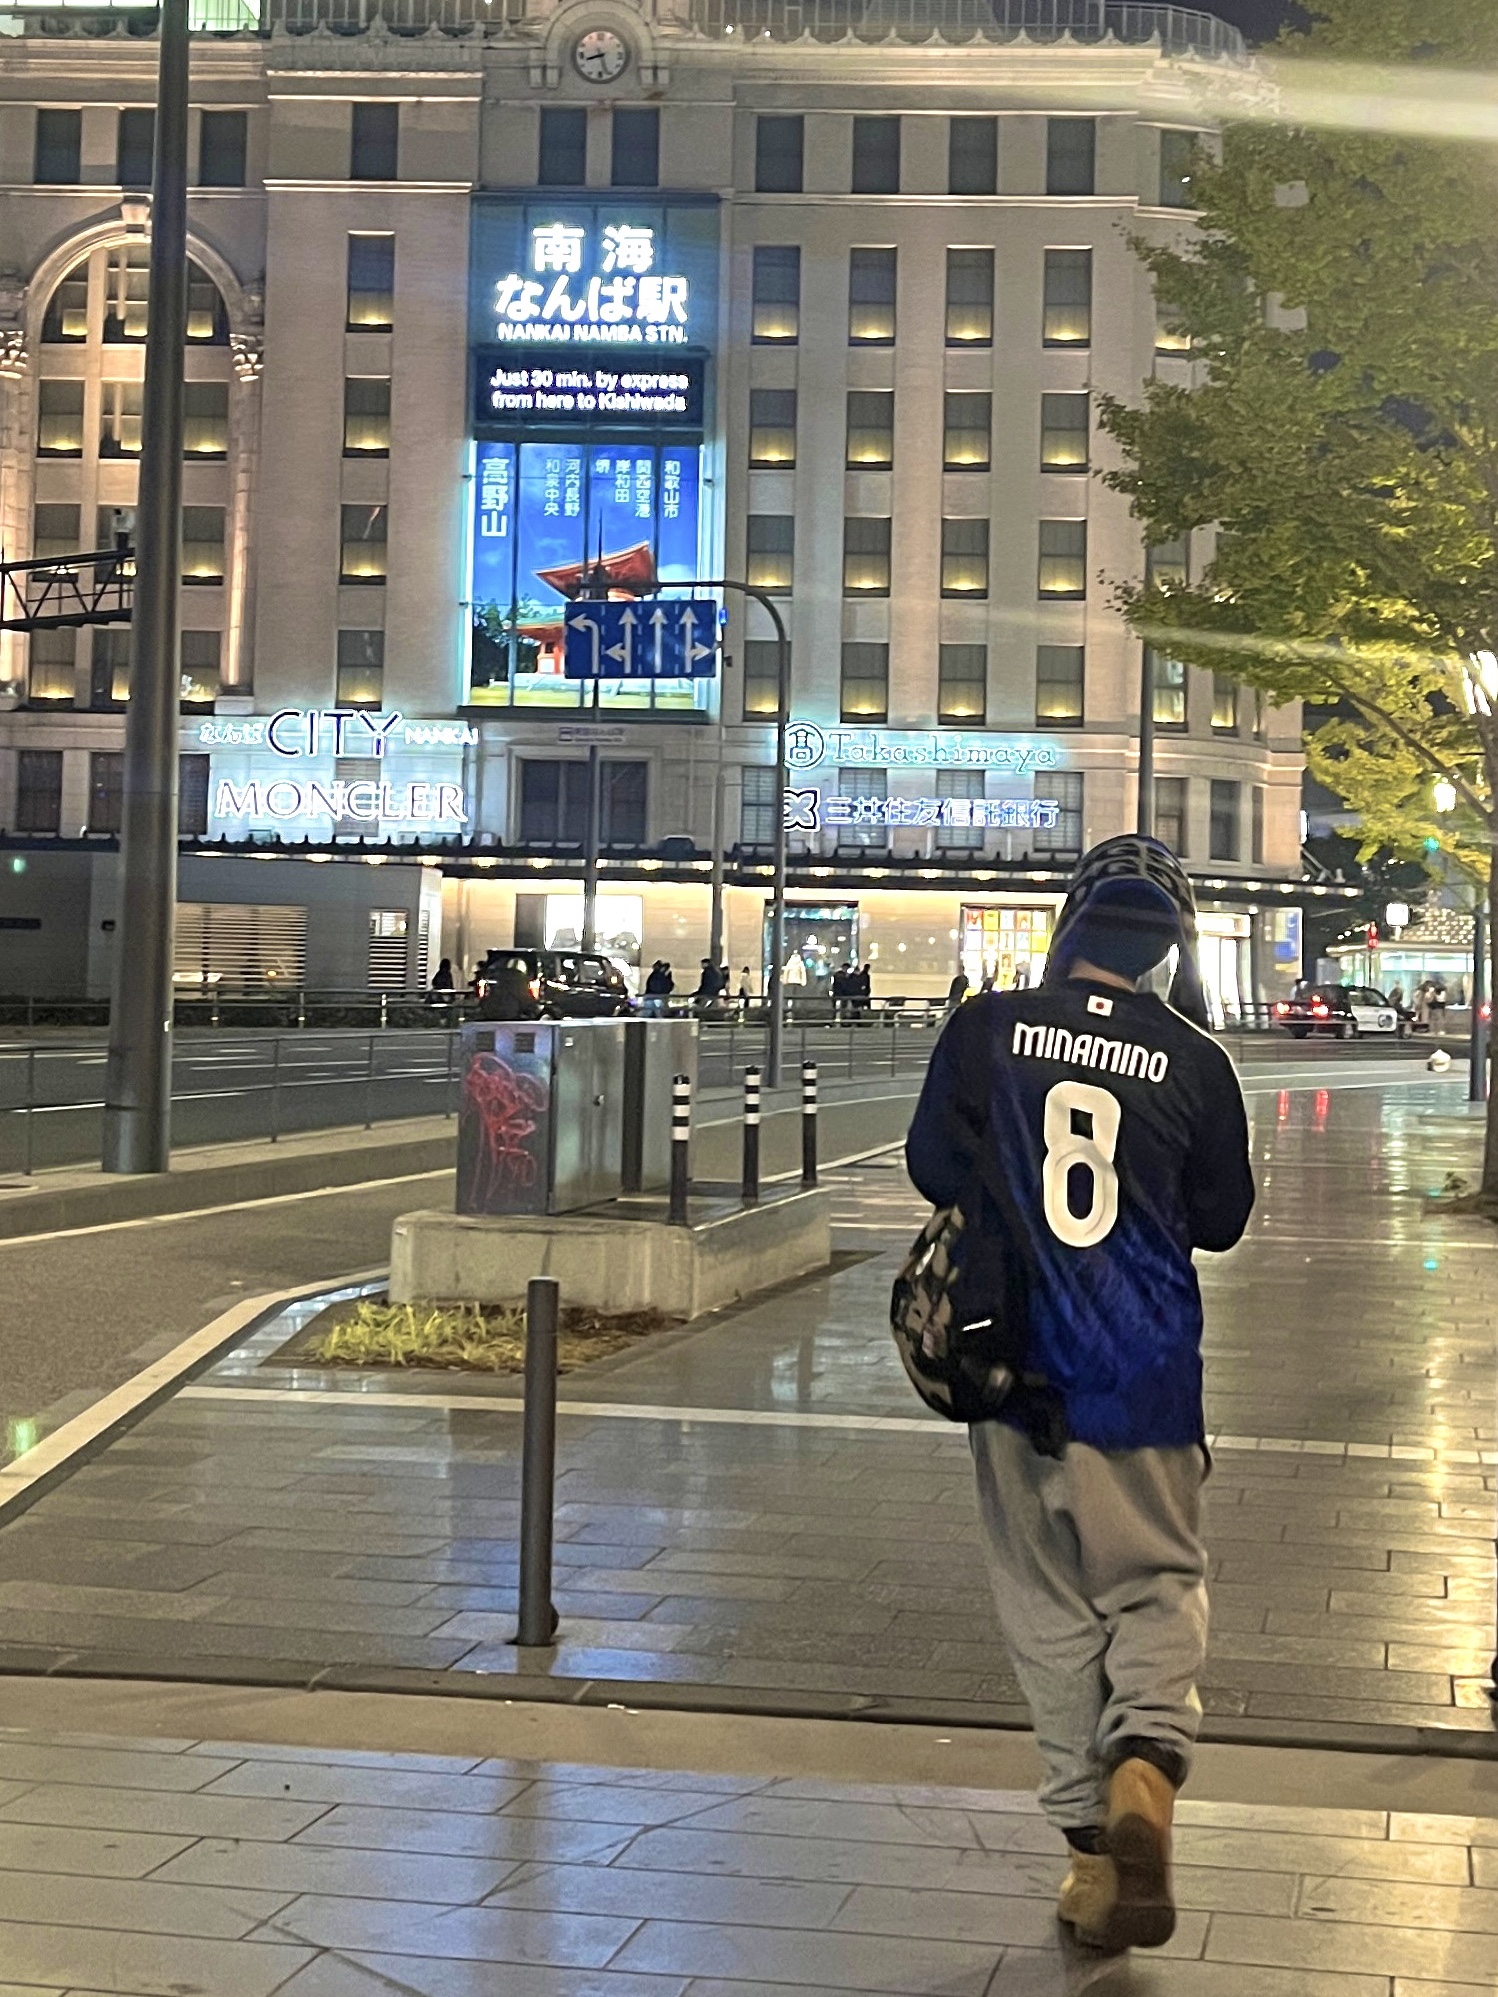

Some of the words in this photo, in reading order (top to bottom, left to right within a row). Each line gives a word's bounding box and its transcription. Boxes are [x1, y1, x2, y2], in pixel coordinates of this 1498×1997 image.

[533, 223, 654, 273] 南海
[495, 273, 689, 323] なんば駅
[497, 323, 570, 341] NANKAI
[573, 324, 642, 342] NAMBA
[645, 325, 688, 343] STN.
[490, 369, 530, 388] Just
[531, 370, 552, 388] 30
[555, 371, 592, 388] min.
[595, 371, 618, 391] by
[621, 374, 689, 391] express
[491, 391, 532, 409] from
[535, 391, 575, 410] here
[577, 393, 596, 411] to
[598, 393, 687, 412] Kishiwada
[480, 457, 509, 537] 高野山
[543, 458, 560, 517] 和泉中央
[563, 458, 582, 517] 河内長野
[614, 459, 631, 503] 岸和田
[634, 459, 652, 519] 関西空港
[663, 460, 681, 519] 和歌山市
[267, 709, 402, 758] CITY
[404, 726, 479, 746] NANKAI
[827, 731, 1056, 775] Takashimaya
[214, 779, 468, 822] MONCLER
[824, 796, 1060, 828] 三井住友信託銀行
[1012, 1021, 1169, 1083] MINAMINO
[1043, 1080, 1121, 1247] 8
